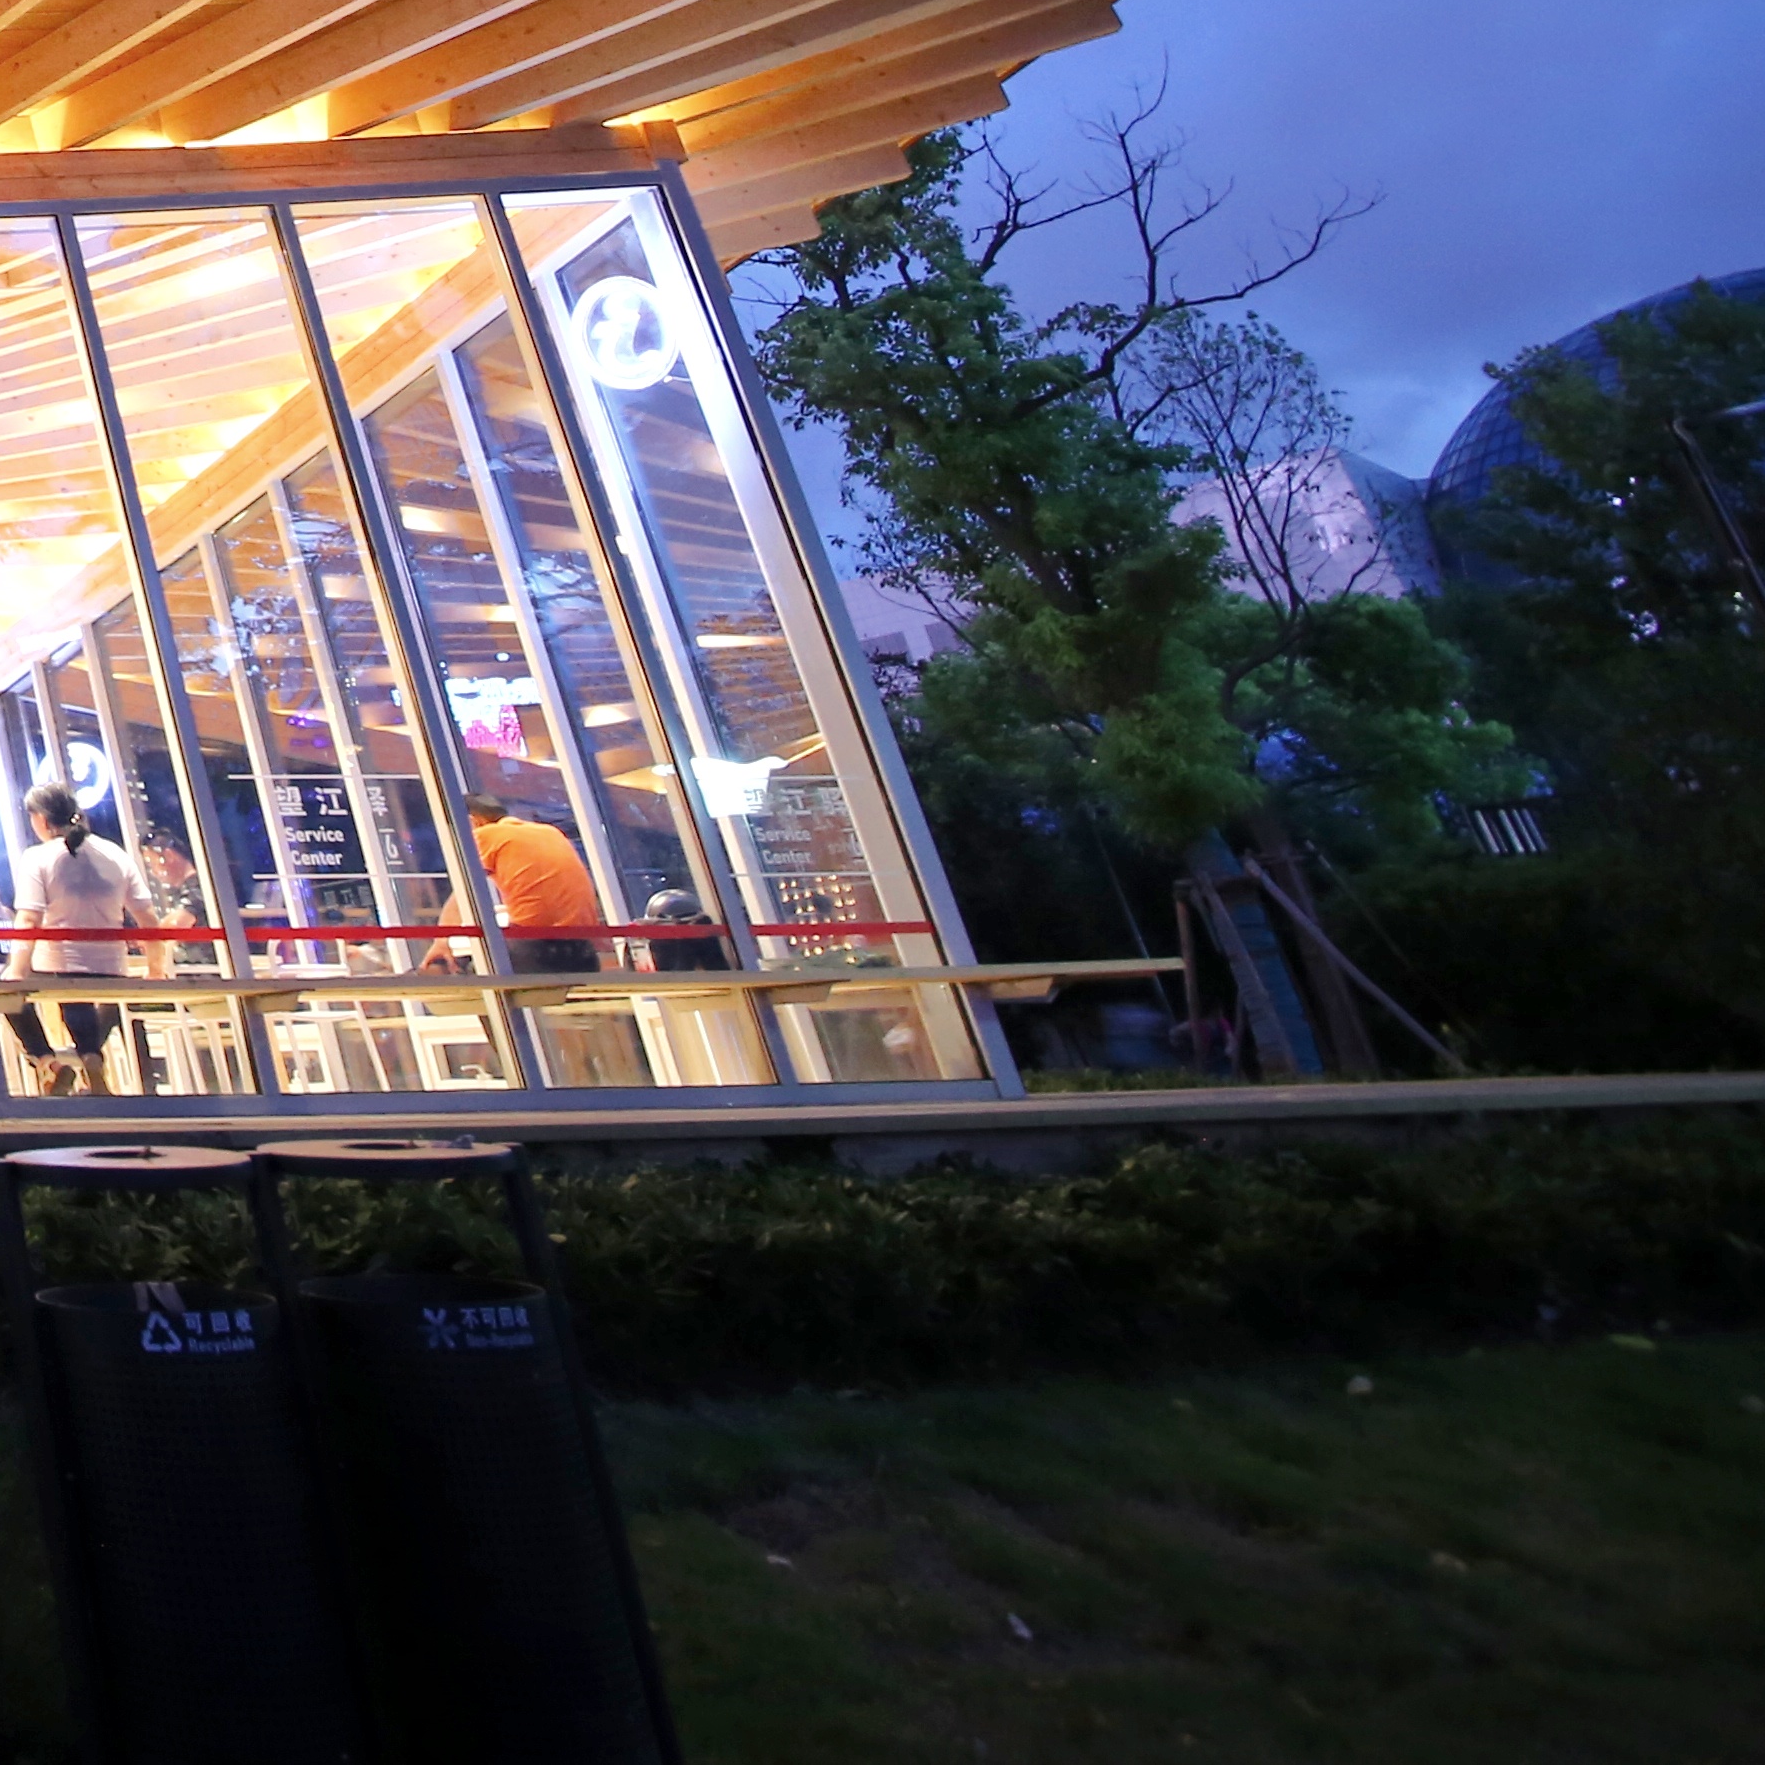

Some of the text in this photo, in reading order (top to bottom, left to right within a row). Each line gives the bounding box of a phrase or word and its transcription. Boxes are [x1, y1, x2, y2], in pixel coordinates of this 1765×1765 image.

[284, 826, 346, 843] Service
[756, 827, 812, 843] Service
[292, 849, 343, 867] Center
[762, 849, 812, 866] Center
[182, 1310, 252, 1334] 可回收
